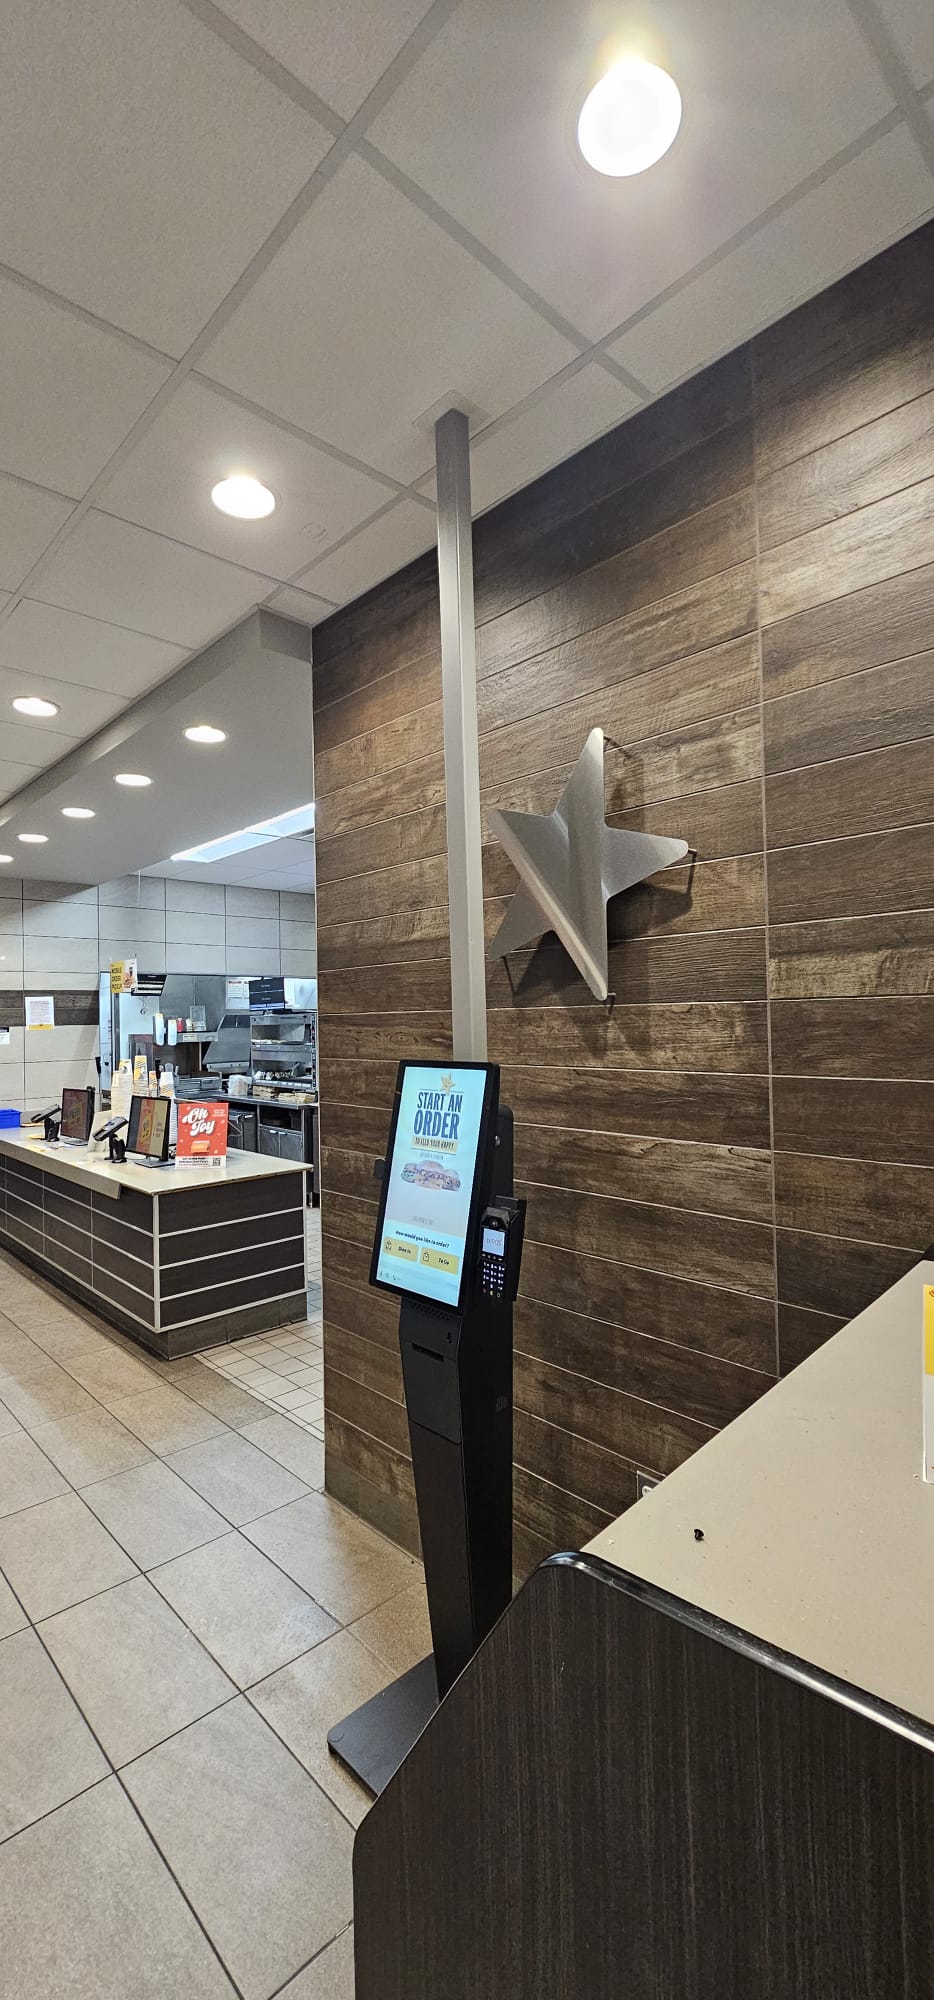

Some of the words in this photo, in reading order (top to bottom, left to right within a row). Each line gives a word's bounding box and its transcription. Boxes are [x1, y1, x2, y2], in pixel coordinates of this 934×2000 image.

[417, 1092, 446, 1111] START
[448, 1095, 463, 1112] AN
[182, 1107, 209, 1124] Oh
[414, 1110, 460, 1140] ORDER
[189, 1119, 216, 1137] Joy
